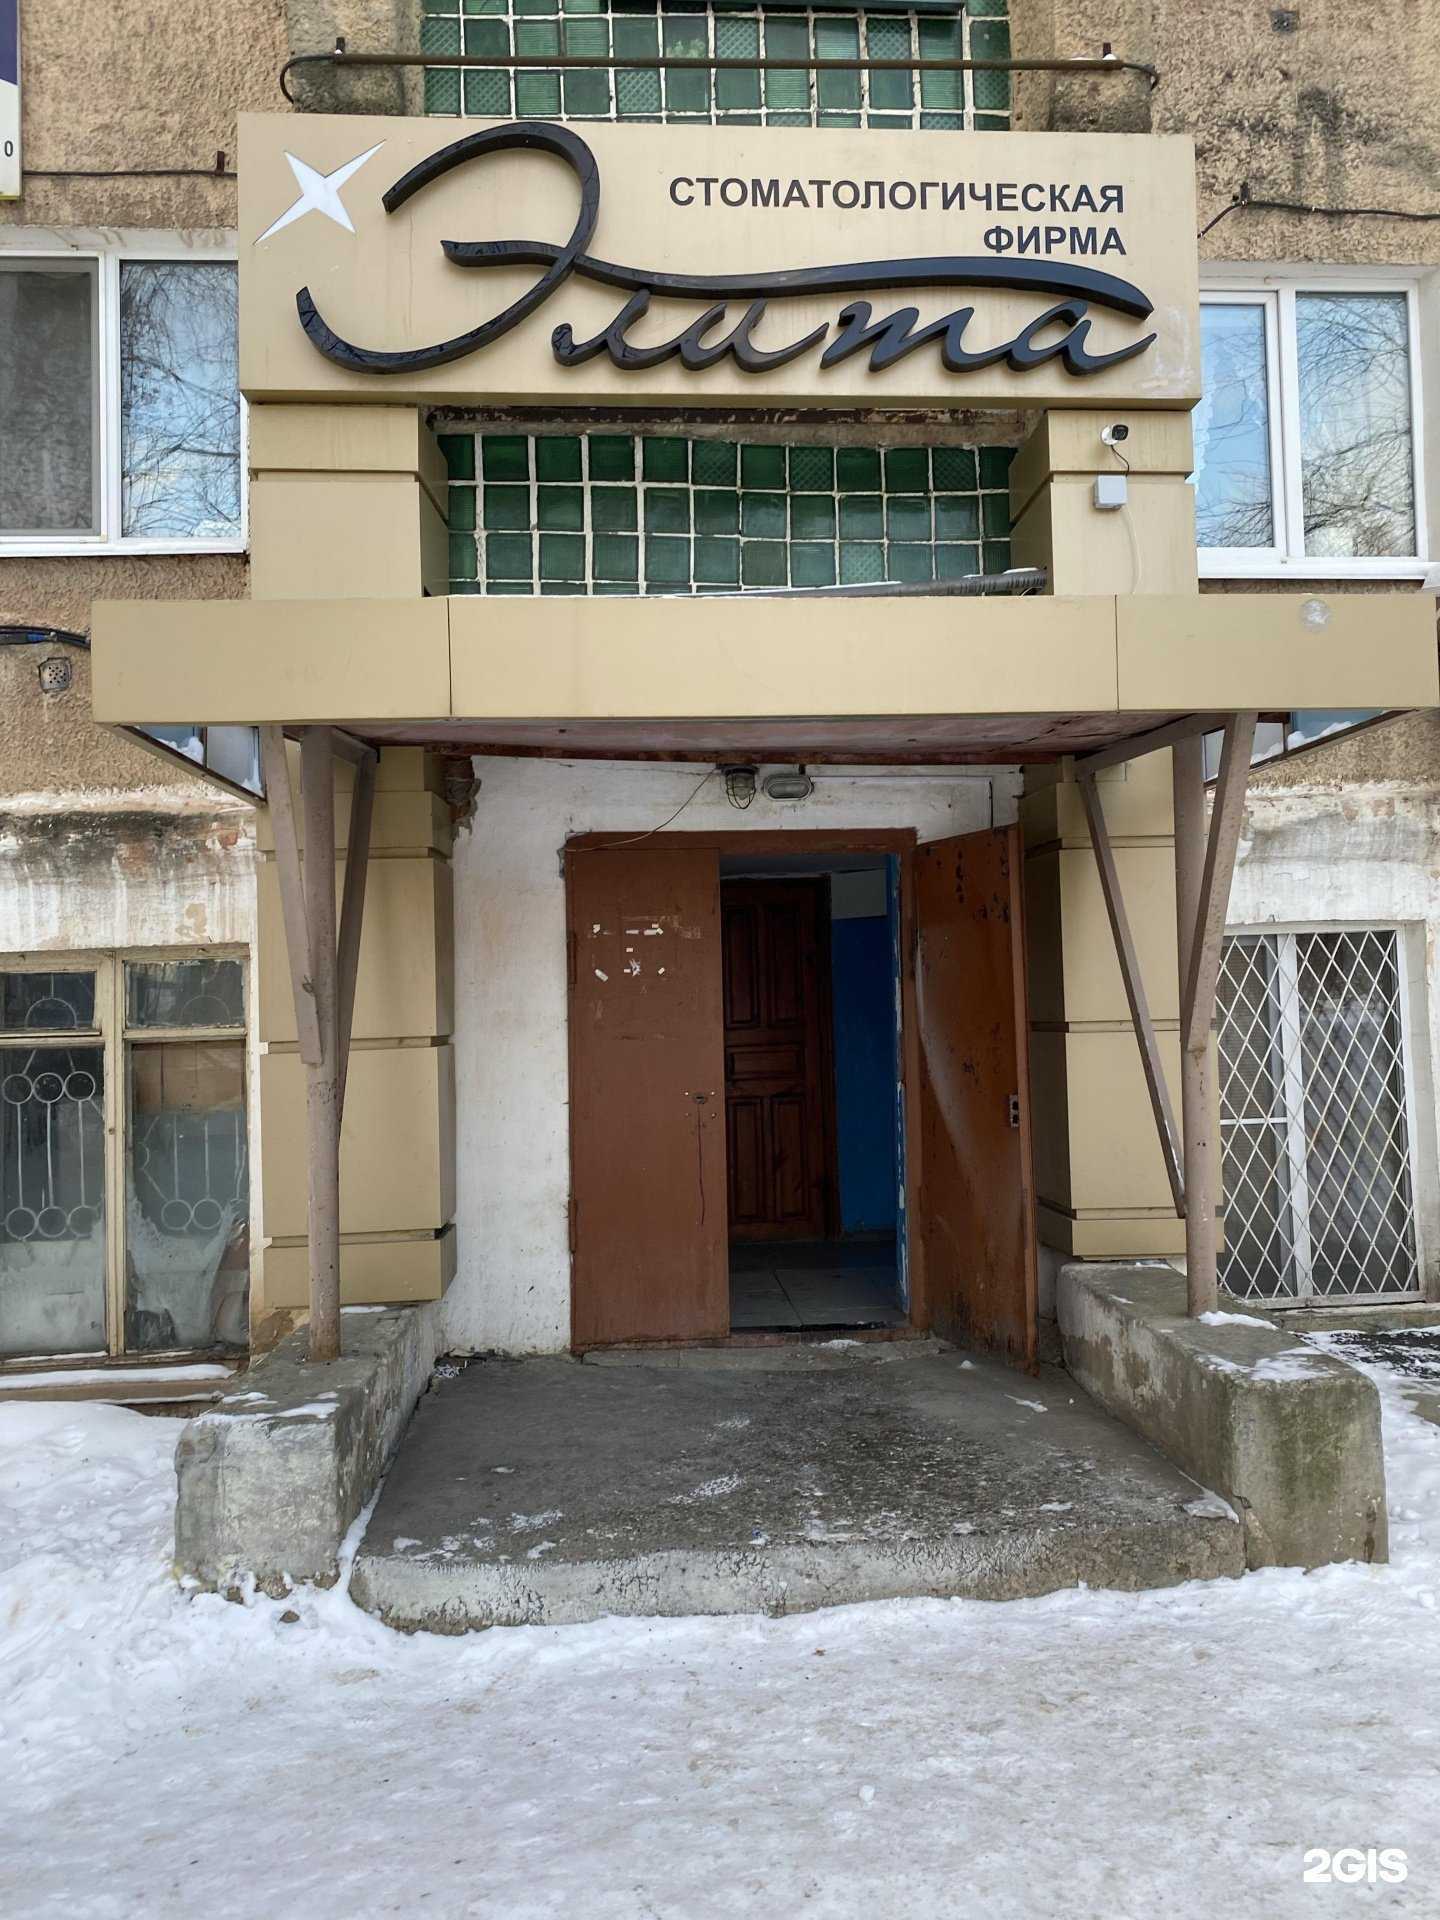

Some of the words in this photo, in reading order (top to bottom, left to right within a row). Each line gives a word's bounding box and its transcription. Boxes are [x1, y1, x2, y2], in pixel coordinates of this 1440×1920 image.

[669, 177, 1125, 214] СТОМАТОЛОГИЧЕСКАЯ
[296, 121, 1157, 376] Элита
[983, 226, 1127, 256] ФИРМА
